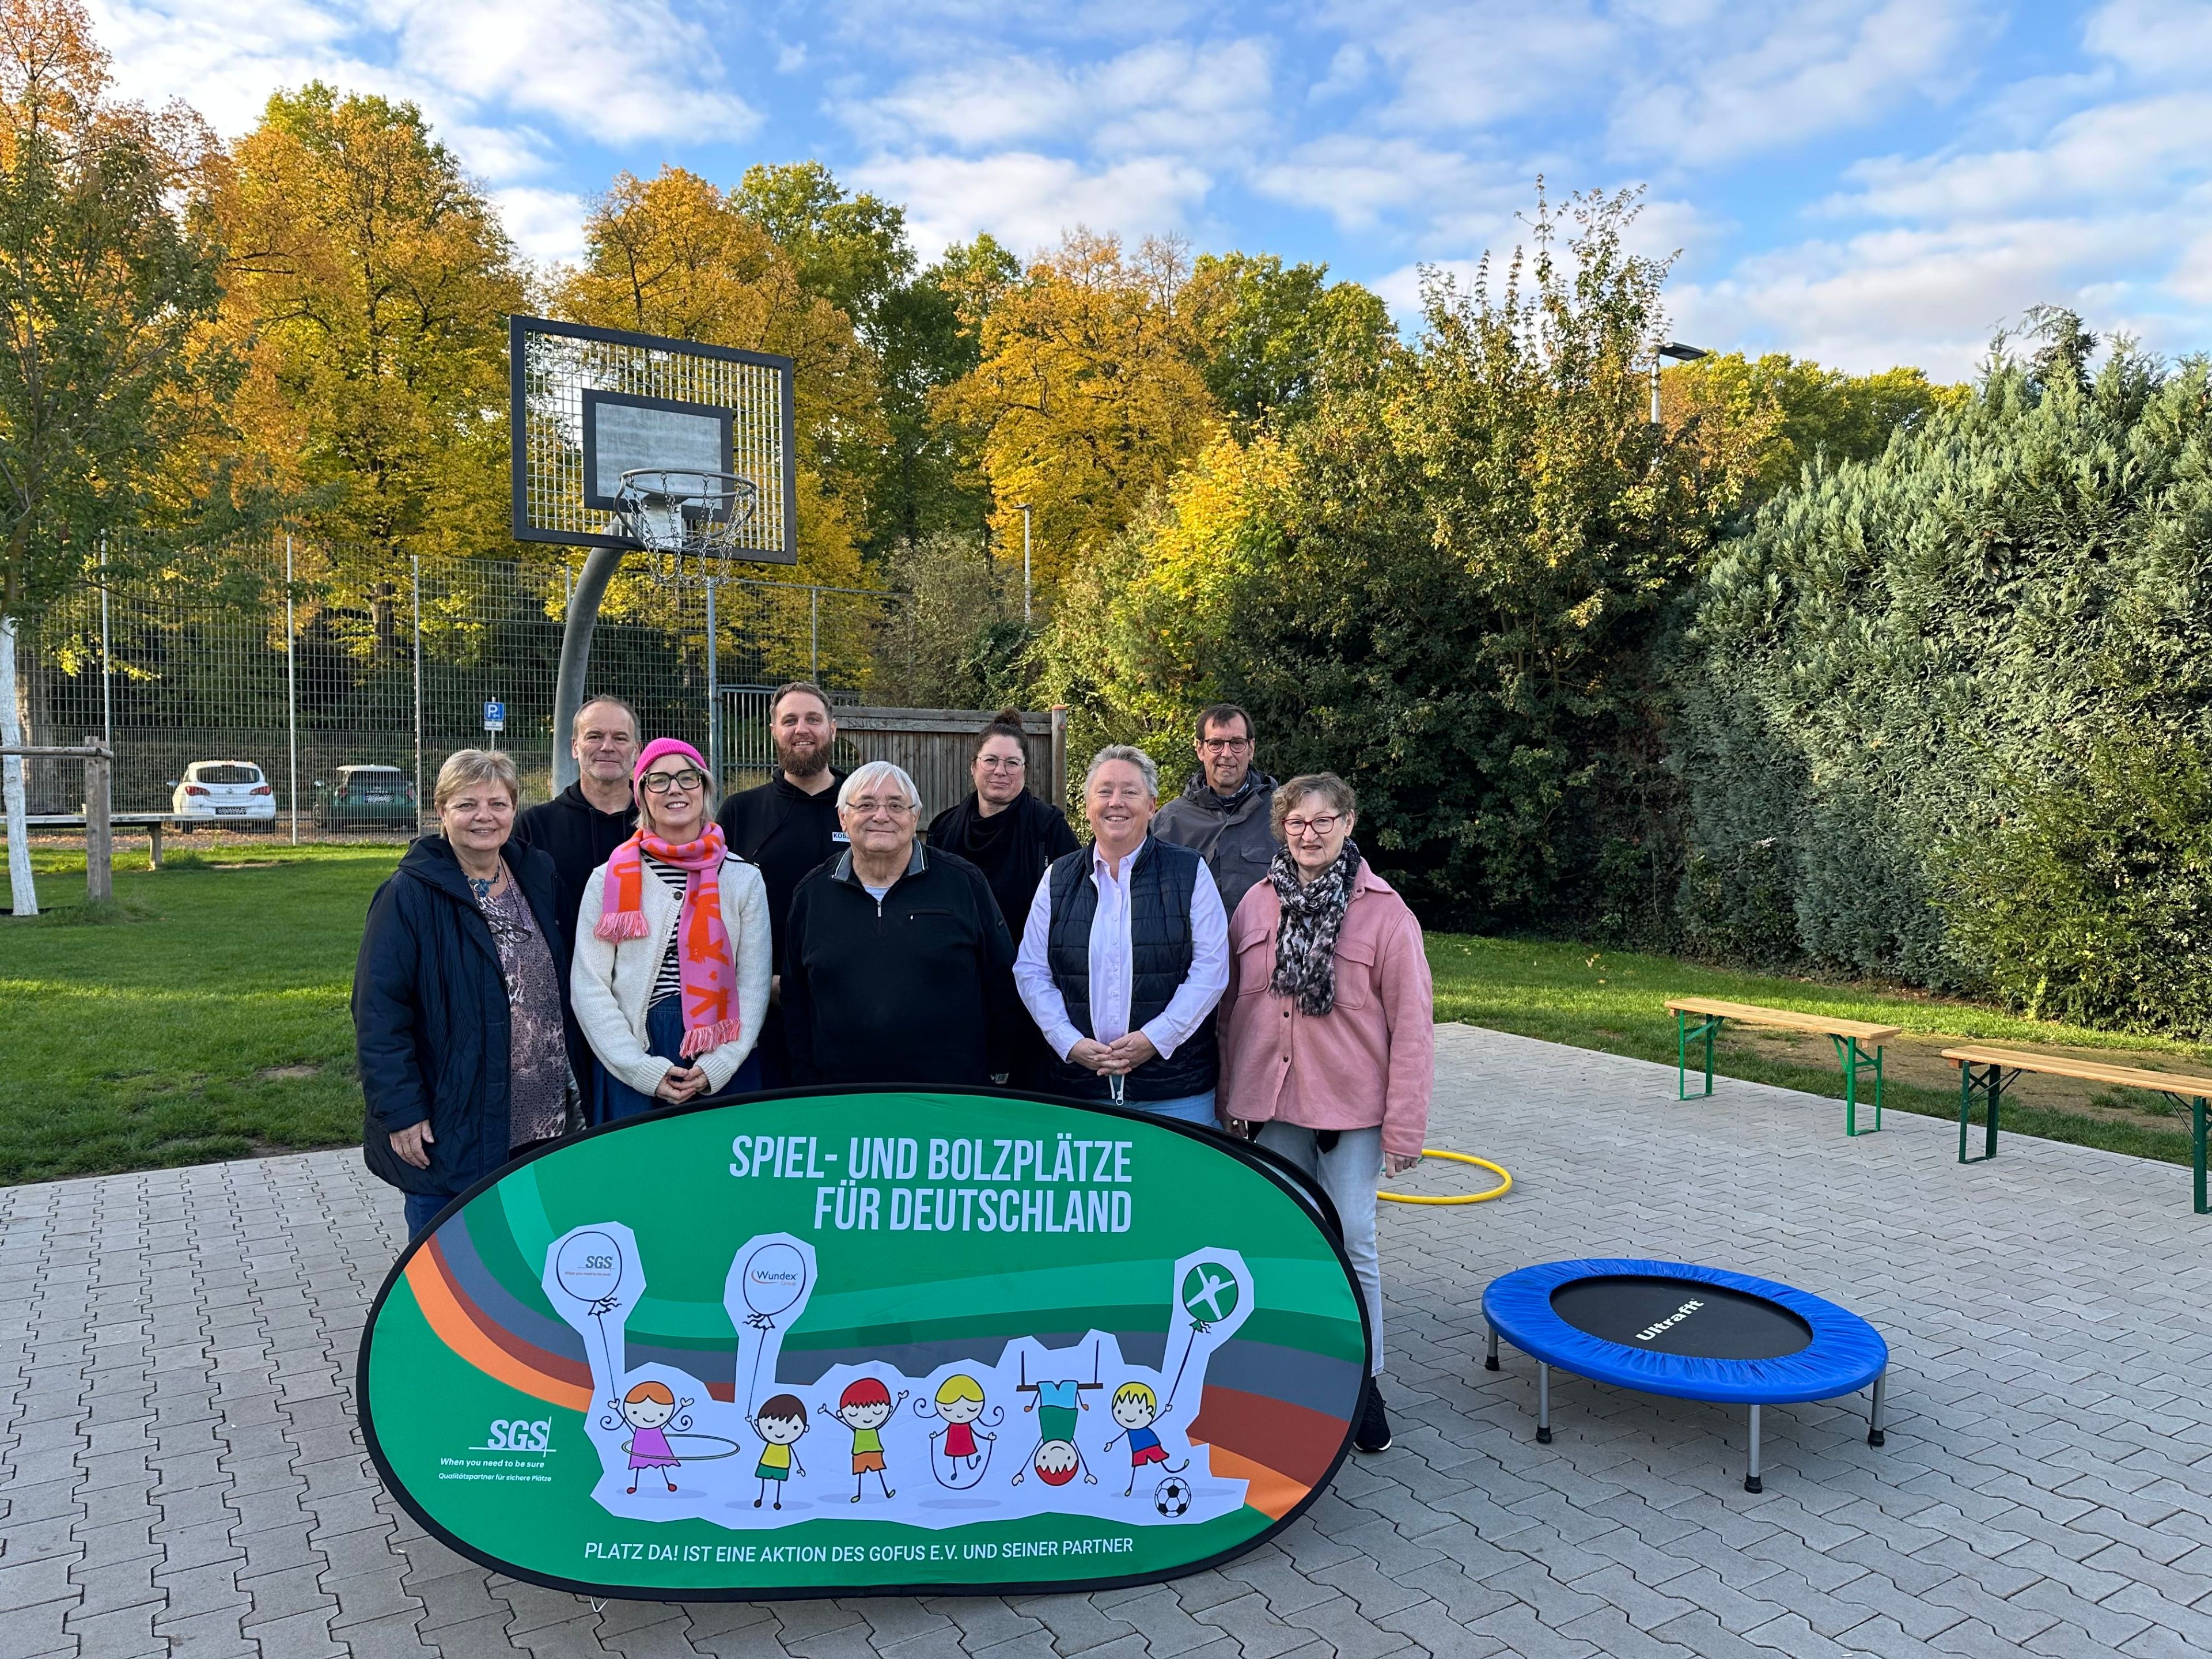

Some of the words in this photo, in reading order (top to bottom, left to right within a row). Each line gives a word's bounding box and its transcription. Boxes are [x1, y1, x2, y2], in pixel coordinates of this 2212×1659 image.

[488, 704, 498, 718] P
[729, 1135, 838, 1178] SPIEL-
[848, 1137, 918, 1180] UND
[928, 1132, 1133, 1183] BOLZPLÄTZE
[814, 1179, 880, 1230] FÜR
[889, 1188, 1132, 1233] DEUTSCHLAND
[585, 1255, 612, 1269] SGS
[756, 1270, 797, 1281] Wundex
[487, 1419, 548, 1450] SGS
[441, 1457, 464, 1466] When
[466, 1460, 482, 1468] you
[483, 1459, 503, 1467] need
[514, 1460, 525, 1468] be
[438, 1472, 495, 1481] Qualitätspartner
[585, 1542, 644, 1560] PLATZ
[648, 1544, 679, 1561] DA!
[683, 1546, 713, 1562] IST
[716, 1546, 756, 1562] EINE
[760, 1546, 826, 1562] AKTION
[832, 1546, 865, 1562] DES
[869, 1545, 926, 1562] GOFUS
[930, 1544, 958, 1560] E.V.
[963, 1543, 997, 1559] UND
[1002, 1540, 1058, 1558] SEINER
[1062, 1537, 1133, 1555] PARTNER
